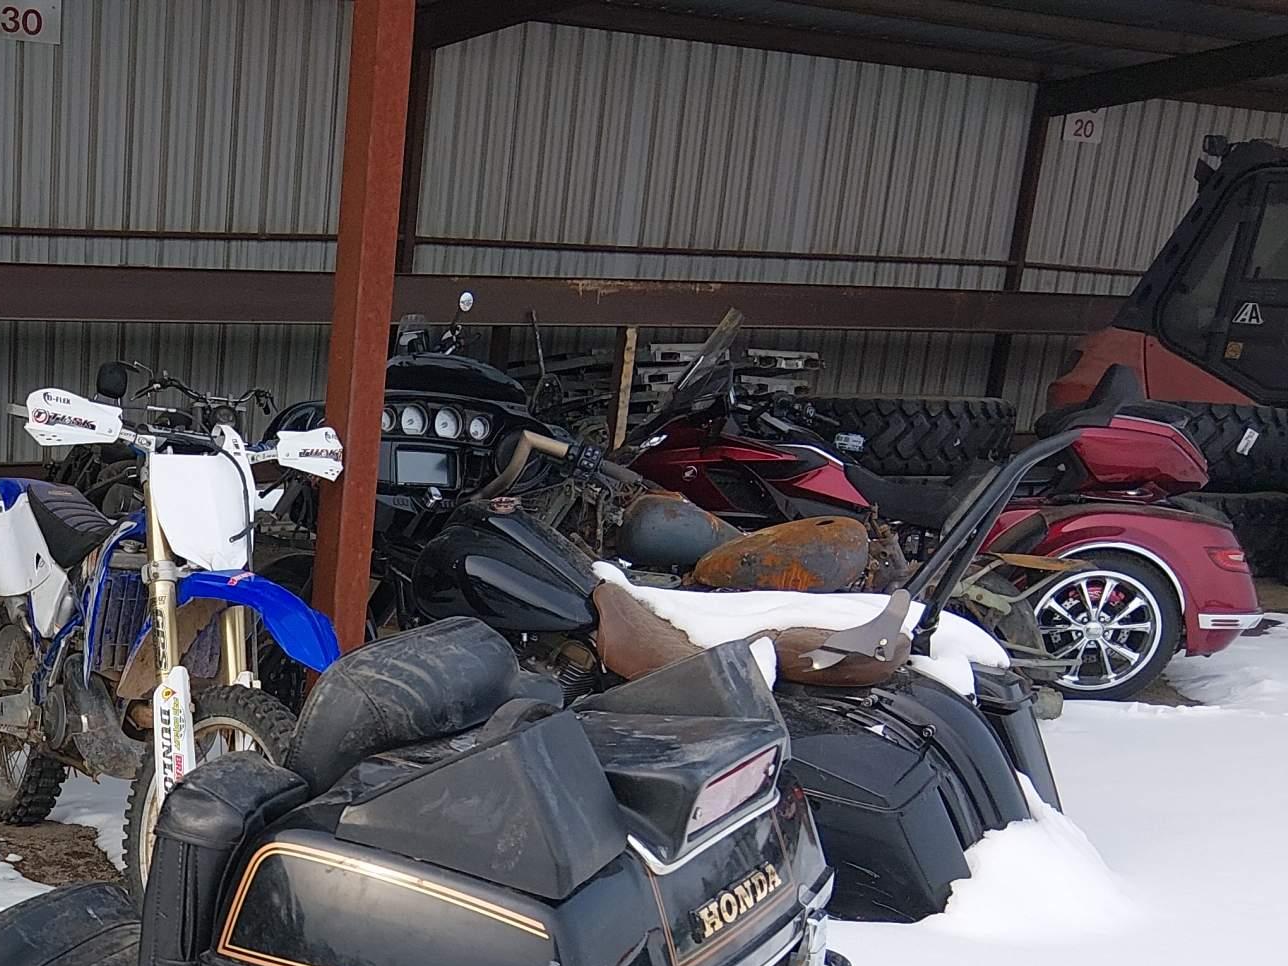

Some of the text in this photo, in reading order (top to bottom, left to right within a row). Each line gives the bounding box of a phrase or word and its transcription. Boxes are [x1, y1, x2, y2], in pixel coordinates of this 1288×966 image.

[1, 6, 43, 36] 30
[1073, 119, 1095, 138] 20
[160, 707, 175, 794] DUNLO
[698, 863, 782, 938] HONDA
